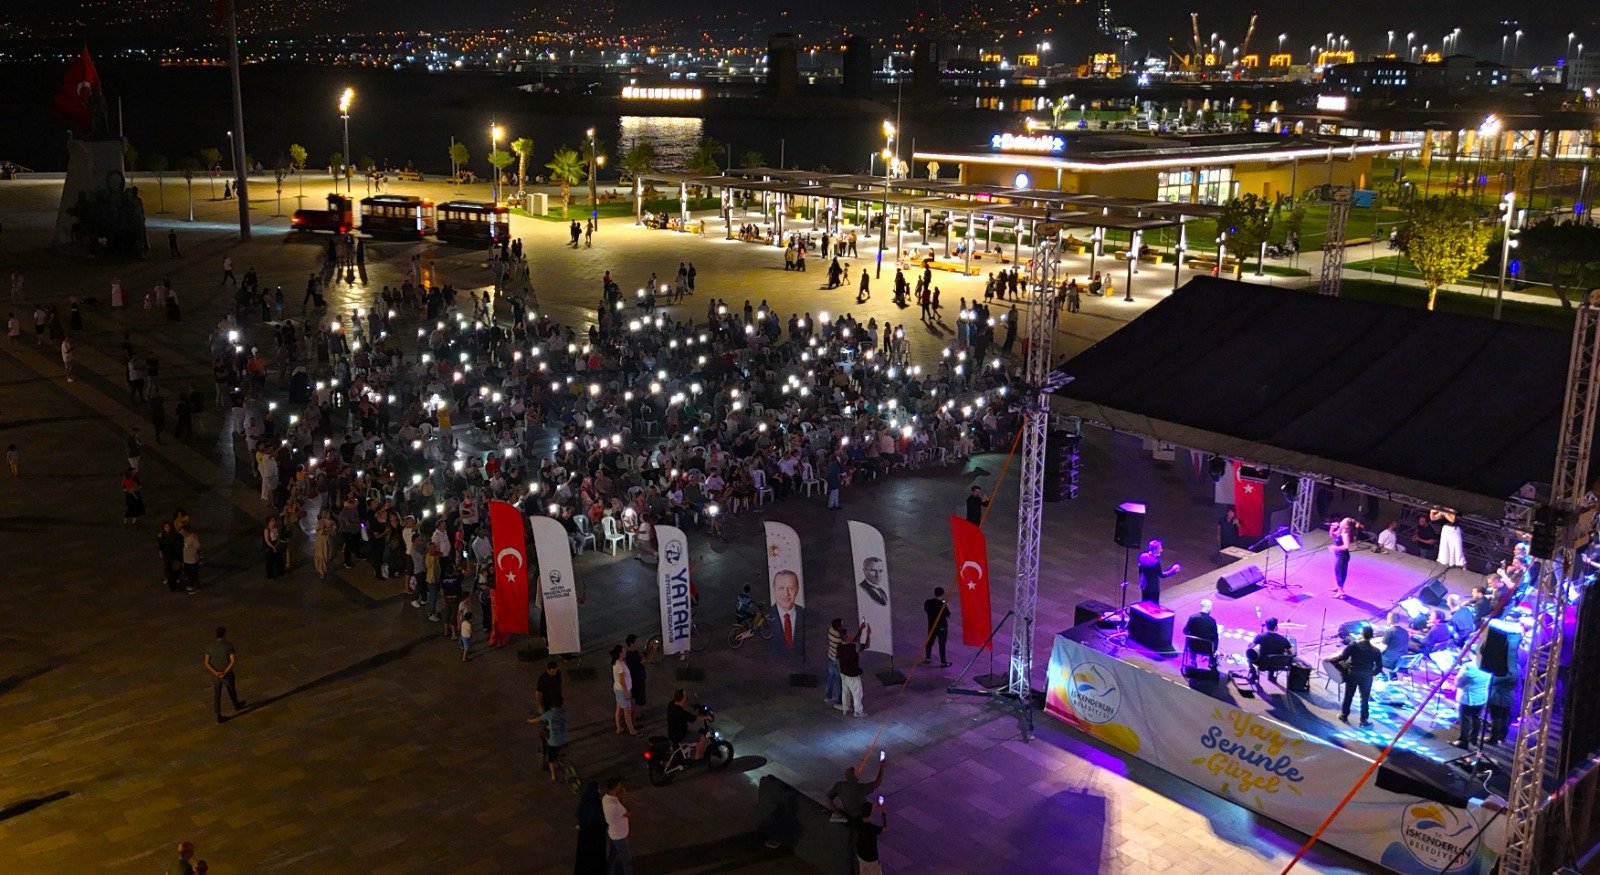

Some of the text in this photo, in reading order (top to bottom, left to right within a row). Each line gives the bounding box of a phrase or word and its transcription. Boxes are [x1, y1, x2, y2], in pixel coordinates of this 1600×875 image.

[1200, 725, 1304, 783] Seninle
[1228, 709, 1287, 755] Yaz
[1206, 752, 1280, 794] Güzel
